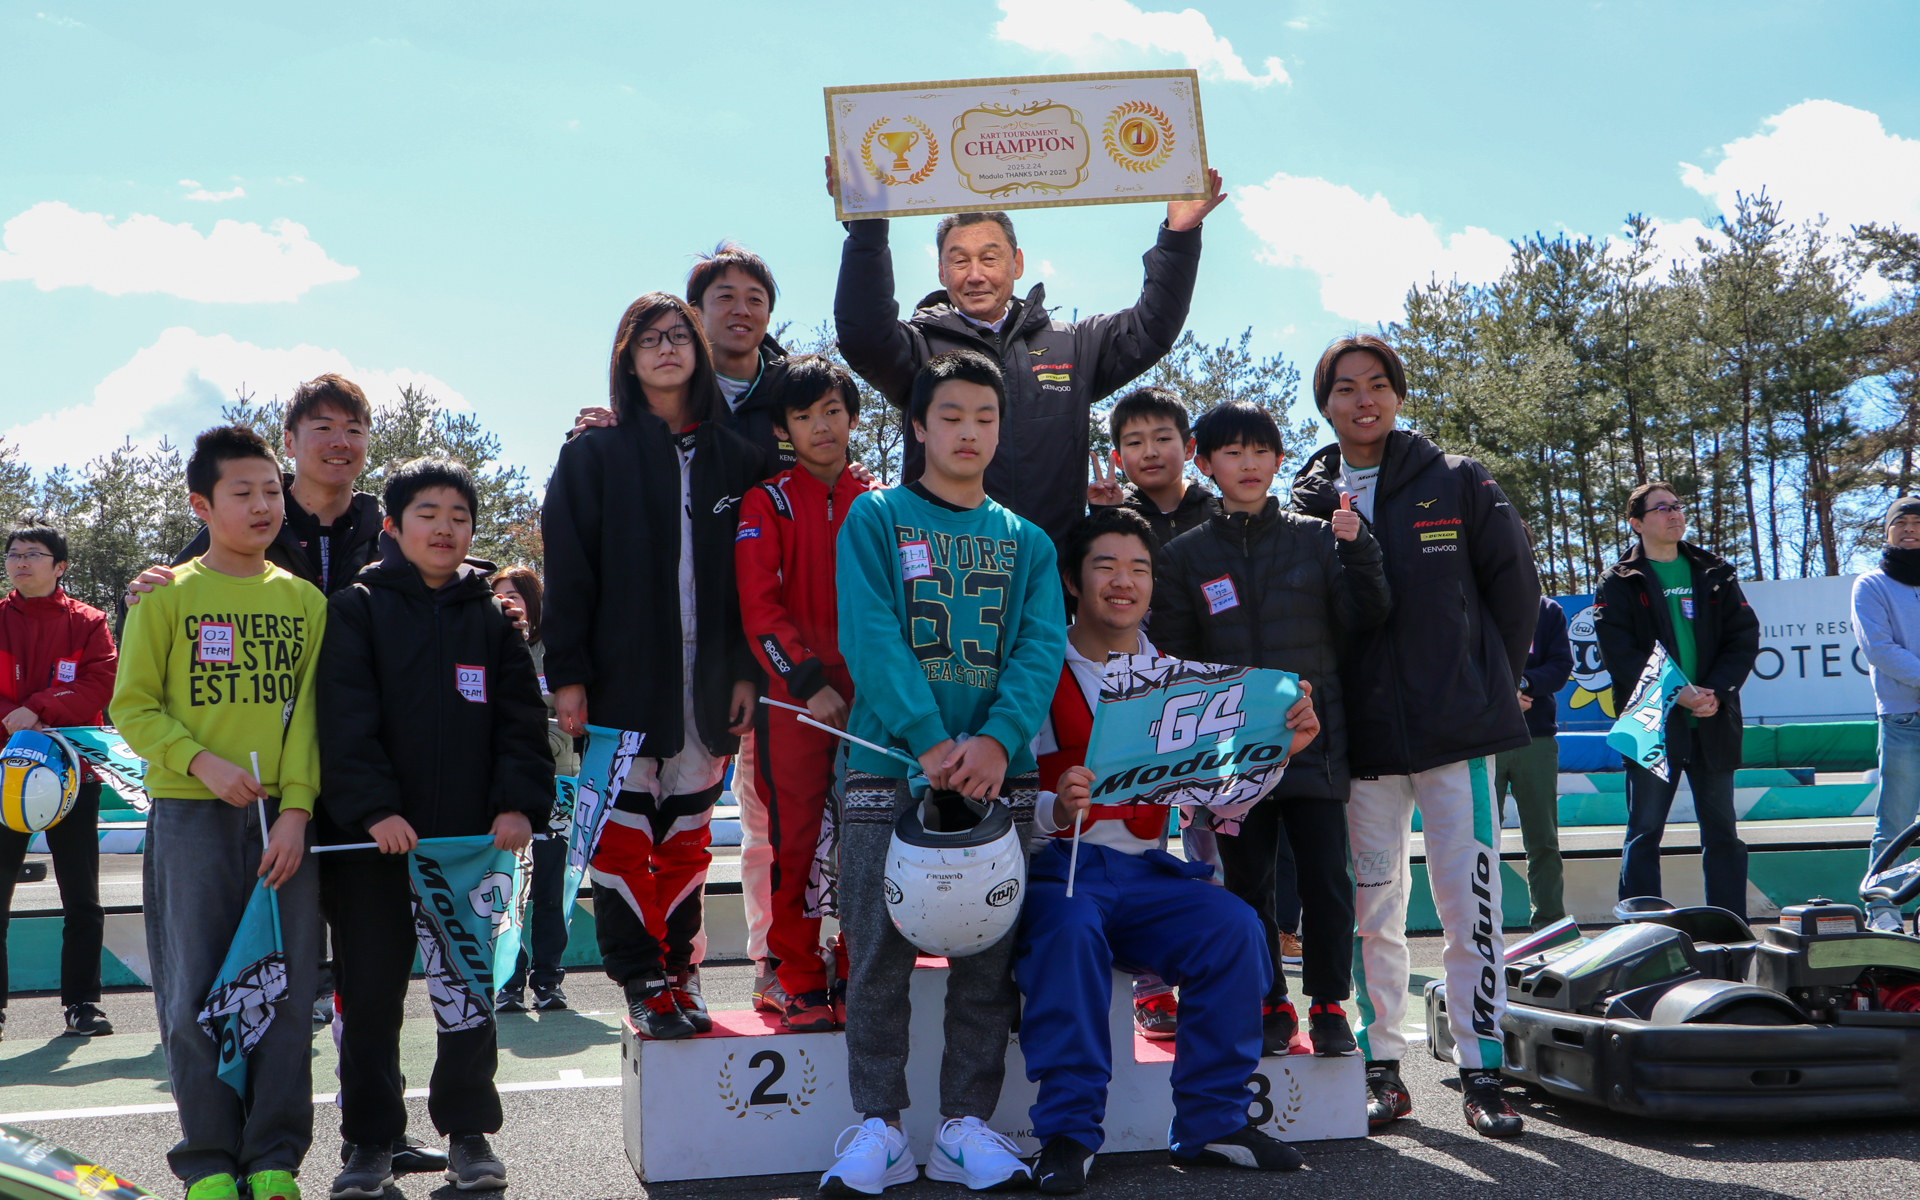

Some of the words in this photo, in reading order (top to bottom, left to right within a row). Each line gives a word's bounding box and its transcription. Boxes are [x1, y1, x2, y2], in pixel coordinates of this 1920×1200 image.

[980, 132, 1001, 140] KART
[1003, 129, 1059, 138] TOURNAMENT
[964, 136, 1075, 156] CHAMPION
[1007, 163, 1042, 171] 2025.2.24
[1032, 363, 1073, 372] Modulo
[1042, 384, 1071, 392] KENWOOD
[1413, 518, 1462, 529] Modulo
[1422, 544, 1457, 553] KENWOOD
[903, 565, 1011, 672] 63
[1573, 623, 1592, 633] Arai
[1759, 623, 1806, 638] ILITY
[1816, 621, 1855, 635] RES
[203, 646, 231, 657] TEAM
[764, 640, 791, 673] sparco
[920, 662, 999, 690] EASONS
[460, 688, 482, 698] TEAM
[1149, 683, 1246, 755] 64
[1091, 742, 1283, 799] Modulo
[1355, 850, 1391, 876] 64
[1356, 880, 1392, 888] Modulo
[991, 882, 1018, 905] Arai
[1471, 851, 1497, 1037] Modulo
[645, 979, 665, 988] PUMA
[748, 1050, 788, 1106] 2
[1243, 1072, 1274, 1127] 3
